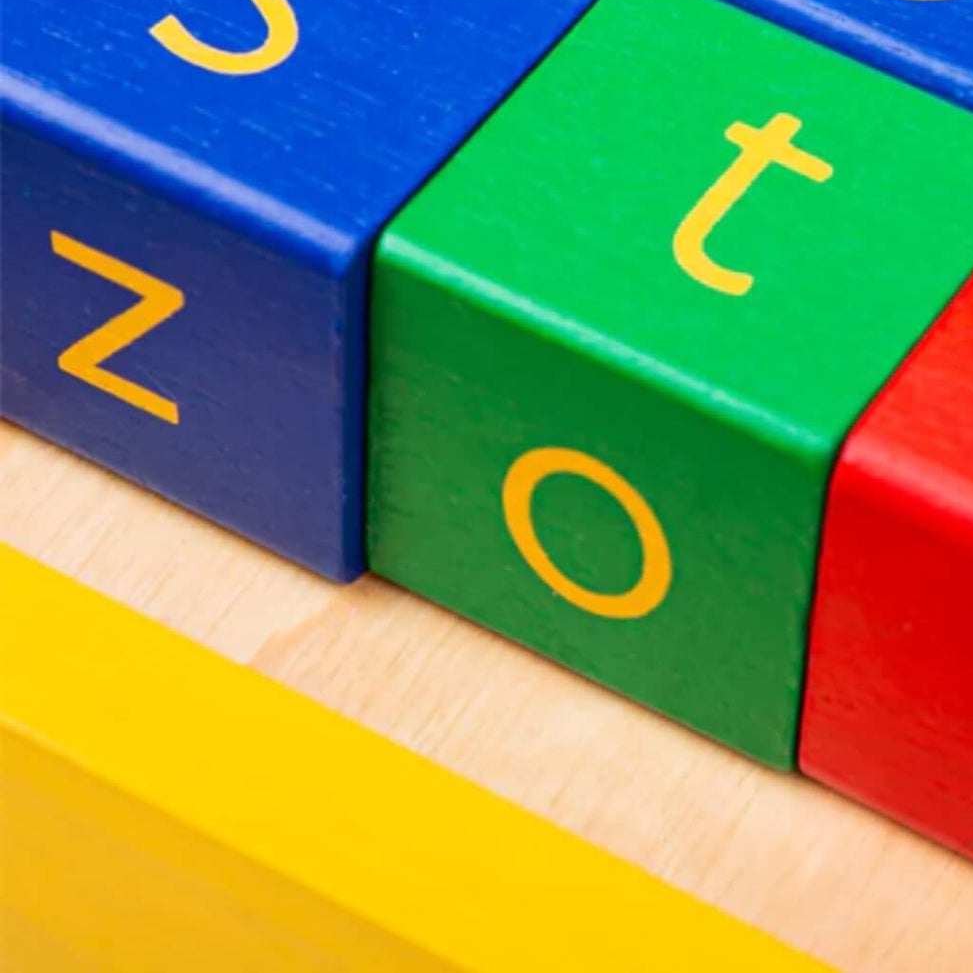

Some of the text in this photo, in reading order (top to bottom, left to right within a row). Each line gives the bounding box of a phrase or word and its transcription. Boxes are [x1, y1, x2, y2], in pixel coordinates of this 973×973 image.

[673, 114, 832, 295] t
[51, 232, 184, 425] z
[502, 447, 672, 619] o
